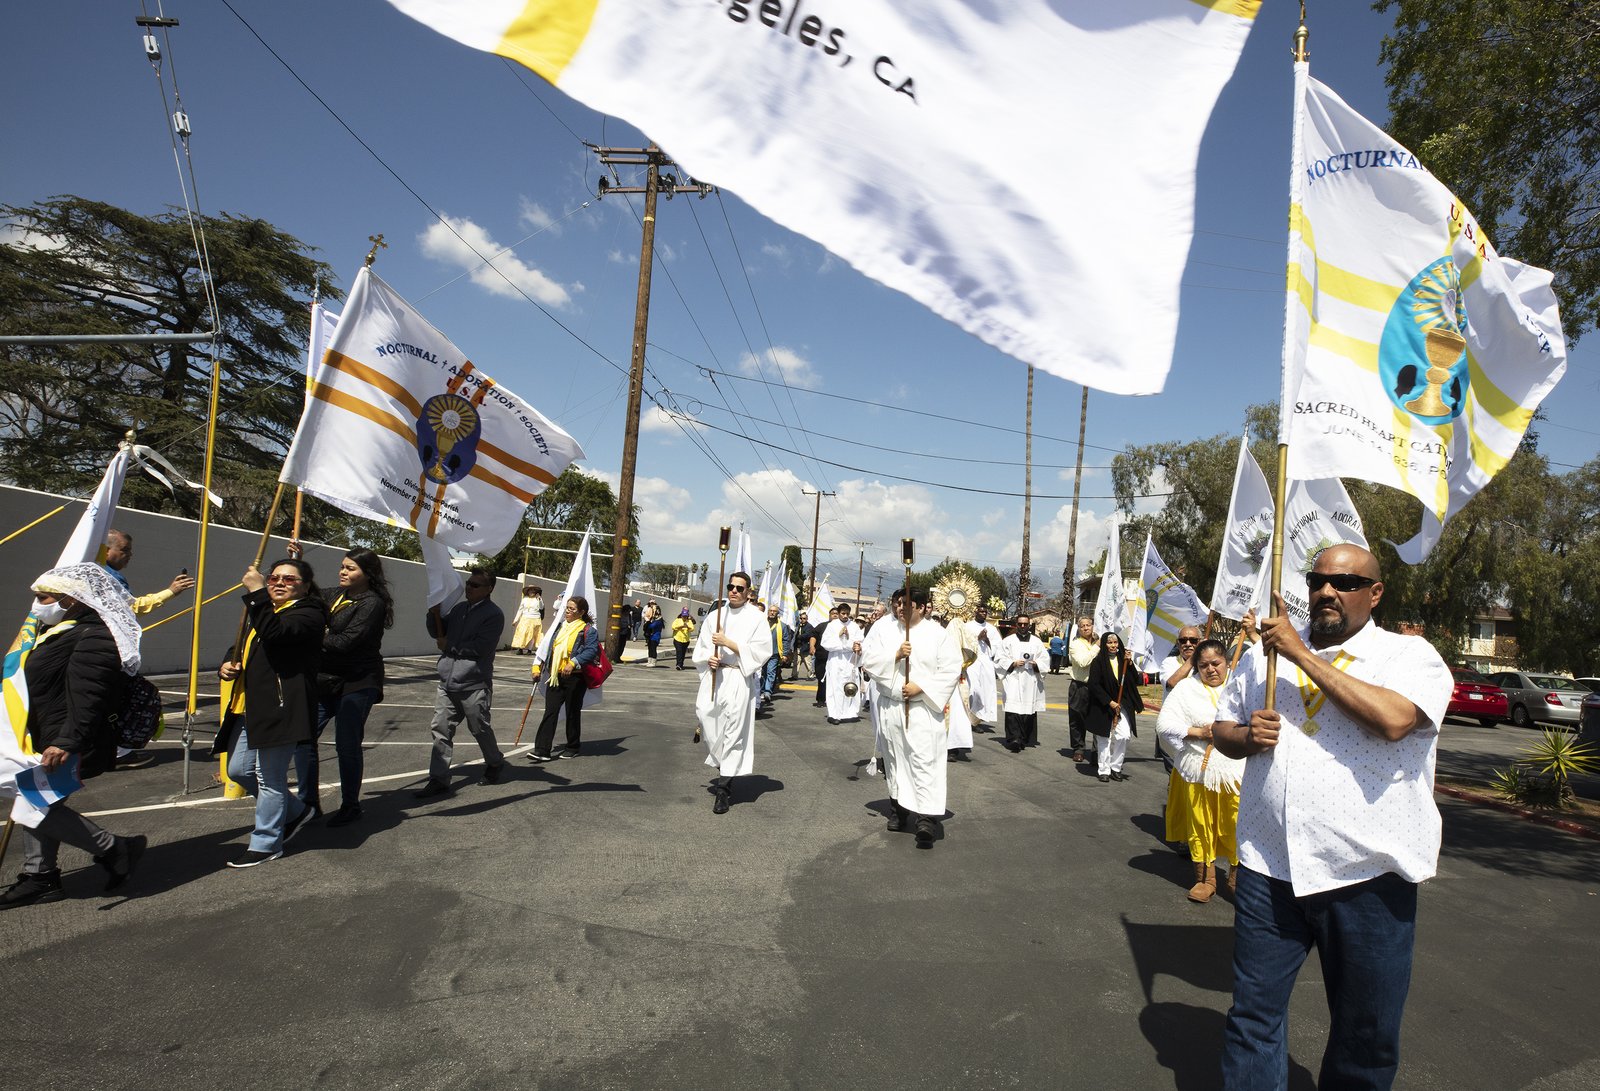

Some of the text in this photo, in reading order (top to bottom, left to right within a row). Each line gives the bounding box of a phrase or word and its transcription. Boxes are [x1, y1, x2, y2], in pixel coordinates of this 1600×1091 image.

[718, 0, 919, 105] geles, CA
[376, 342, 550, 456] NOCTURNAL ADORATION SOCIETY
[1293, 401, 1359, 420] SACRED
[1361, 415, 1404, 448] HEART
[1322, 424, 1365, 443] JUNE
[380, 477, 412, 500] November
[443, 512, 466, 528] Angeles
[465, 523, 475, 532] CA
[440, 499, 459, 513] Parish
